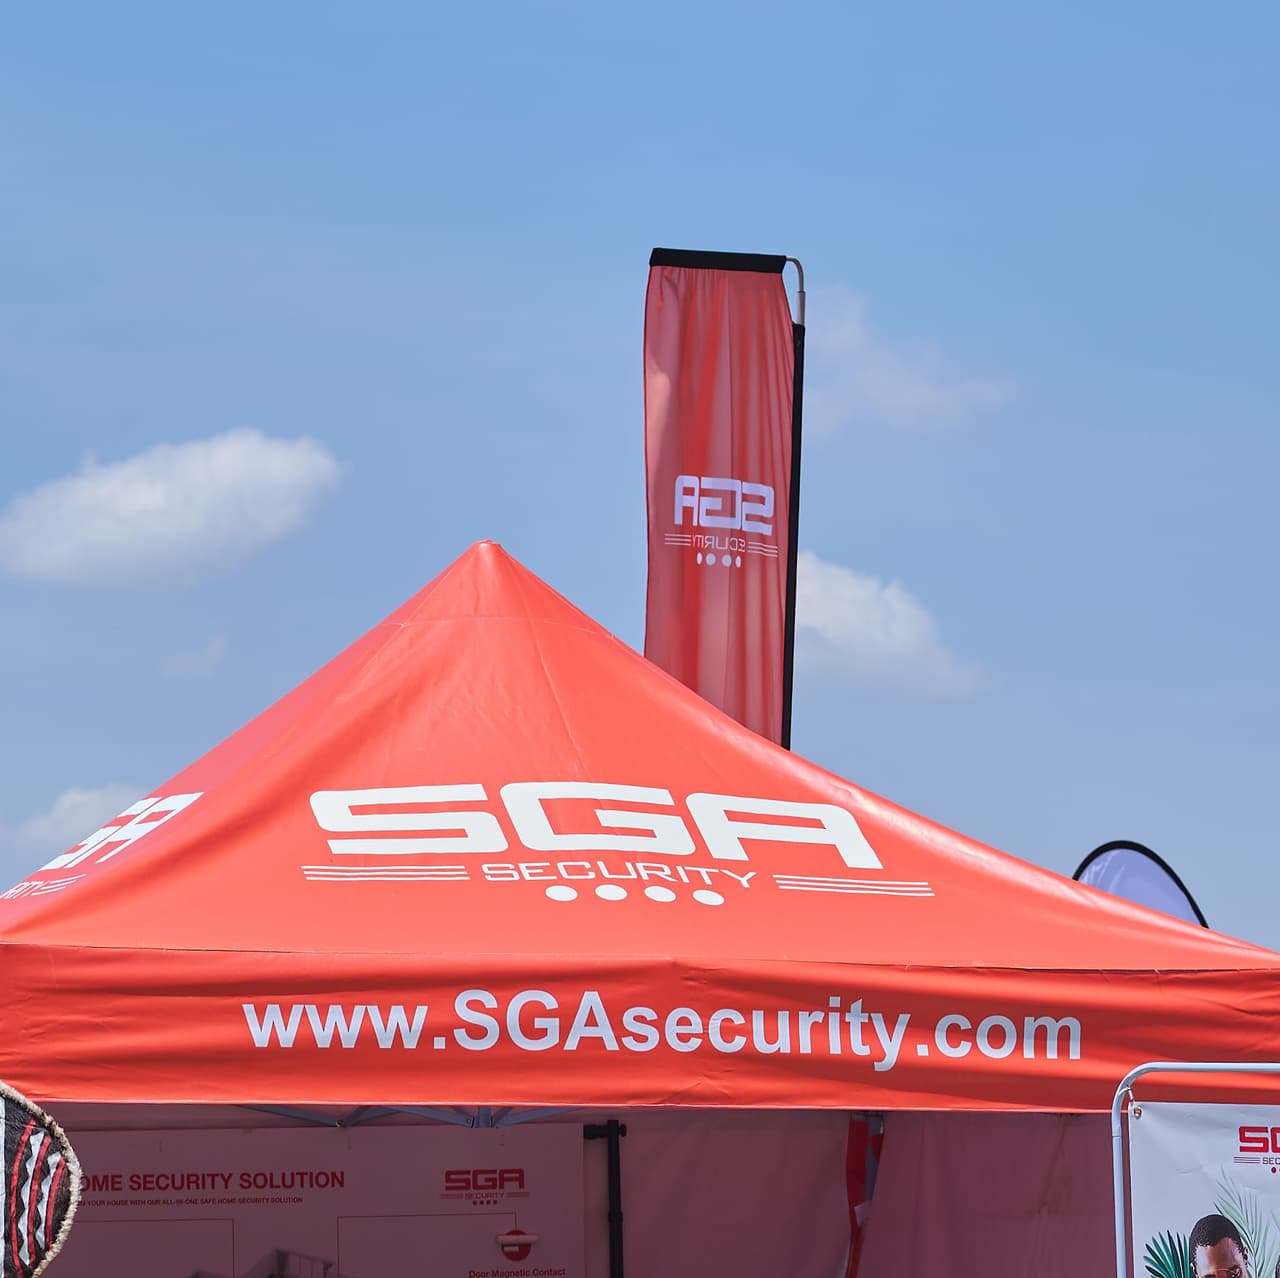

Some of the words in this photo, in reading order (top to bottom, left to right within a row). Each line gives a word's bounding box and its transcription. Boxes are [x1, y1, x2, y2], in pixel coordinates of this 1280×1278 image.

[309, 782, 883, 869] SGA
[483, 860, 757, 892] SECURITY
[242, 988, 1083, 1072] www.SGAsecurity.com
[81, 1174, 123, 1192] OME
[129, 1173, 233, 1191] SECURITY
[239, 1171, 345, 1190] SOLUTION
[445, 1168, 525, 1191] SGA
[464, 1191, 505, 1200] SECURITY
[468, 1269, 490, 1278] Door
[532, 1267, 566, 1278] Contact
